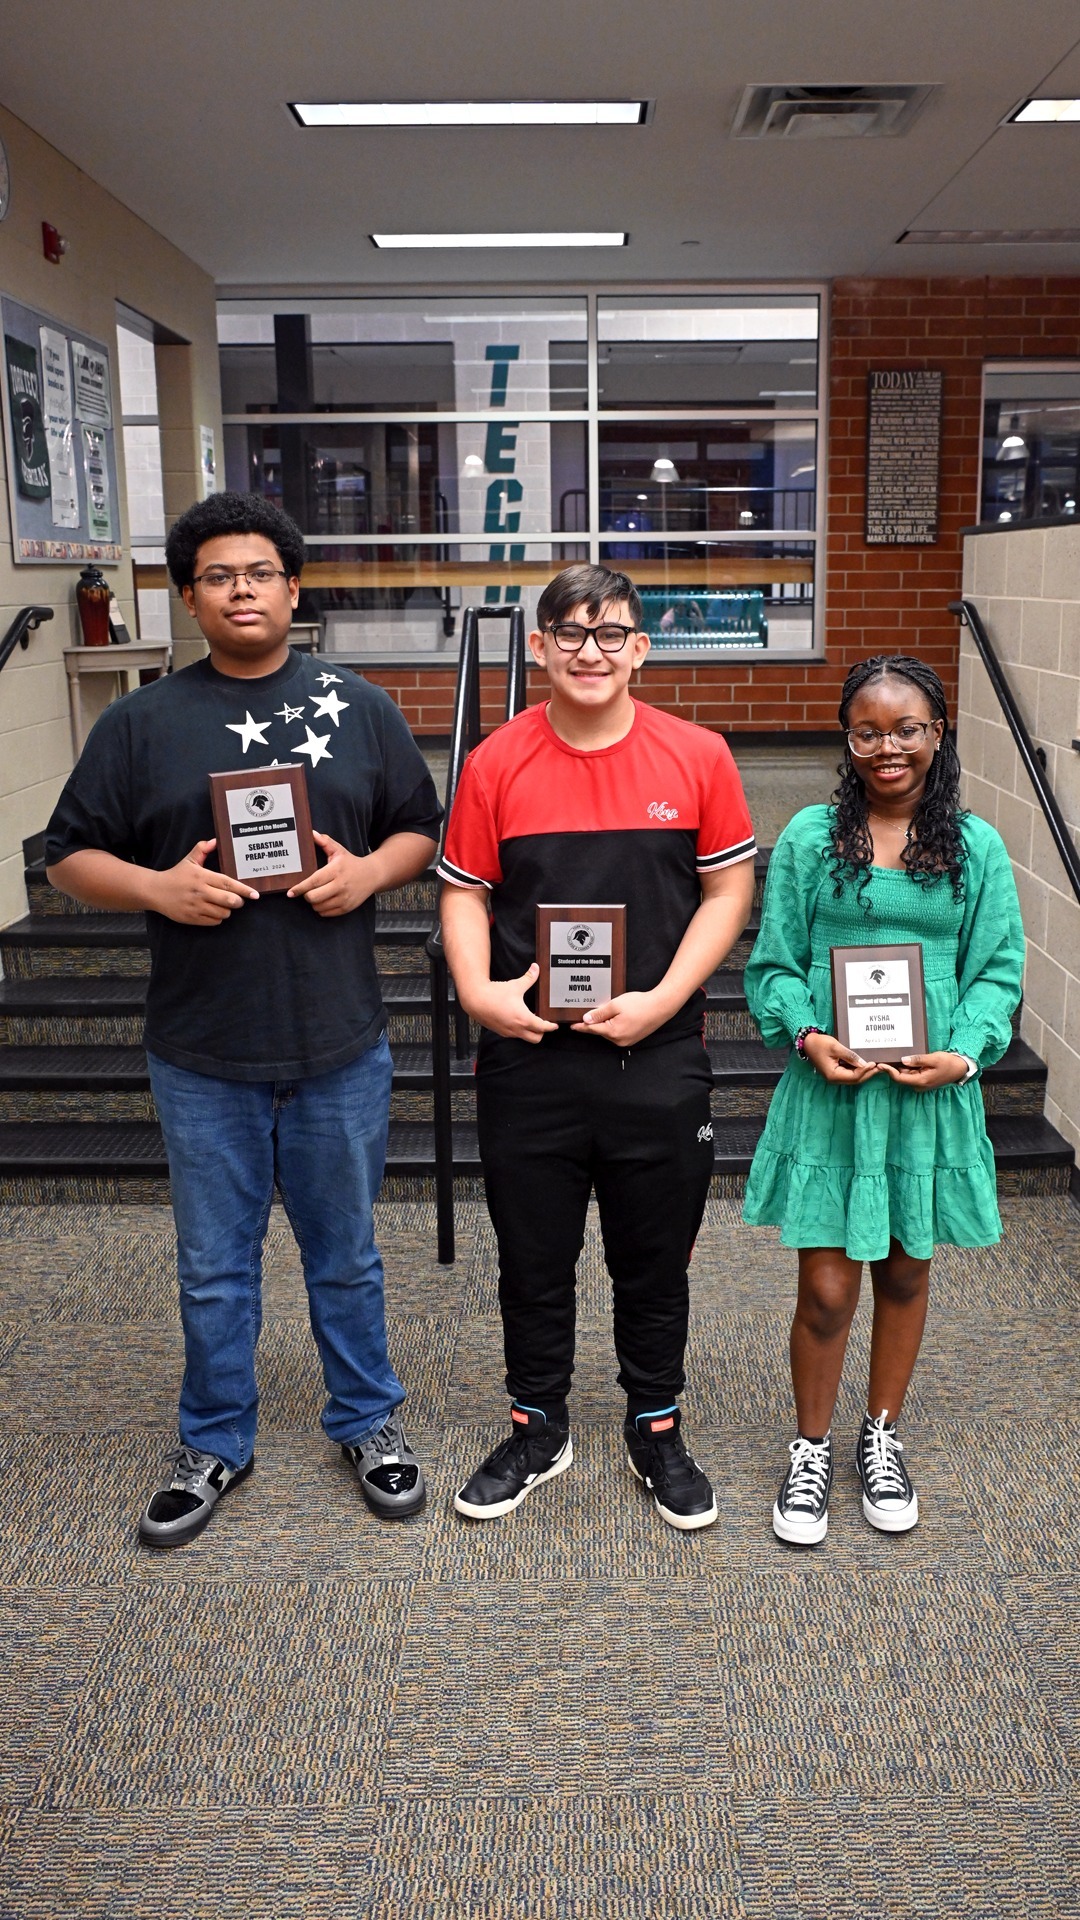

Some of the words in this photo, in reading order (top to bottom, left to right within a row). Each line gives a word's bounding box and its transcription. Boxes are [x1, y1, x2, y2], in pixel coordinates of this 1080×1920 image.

[871, 371, 916, 389] TODAY
[868, 510, 887, 518] SMILE
[888, 510, 896, 518] AT
[868, 525, 883, 534] THIS
[885, 525, 892, 534] IS
[893, 525, 912, 534] YOUR
[867, 535, 887, 543] MAKE
[888, 535, 895, 543] IT
[239, 825, 258, 834] Student
[264, 823, 272, 831] the
[248, 840, 284, 851] SEBASTIAN
[245, 849, 289, 861] PREAP-MOREL
[568, 984, 592, 992] NOYOLA
